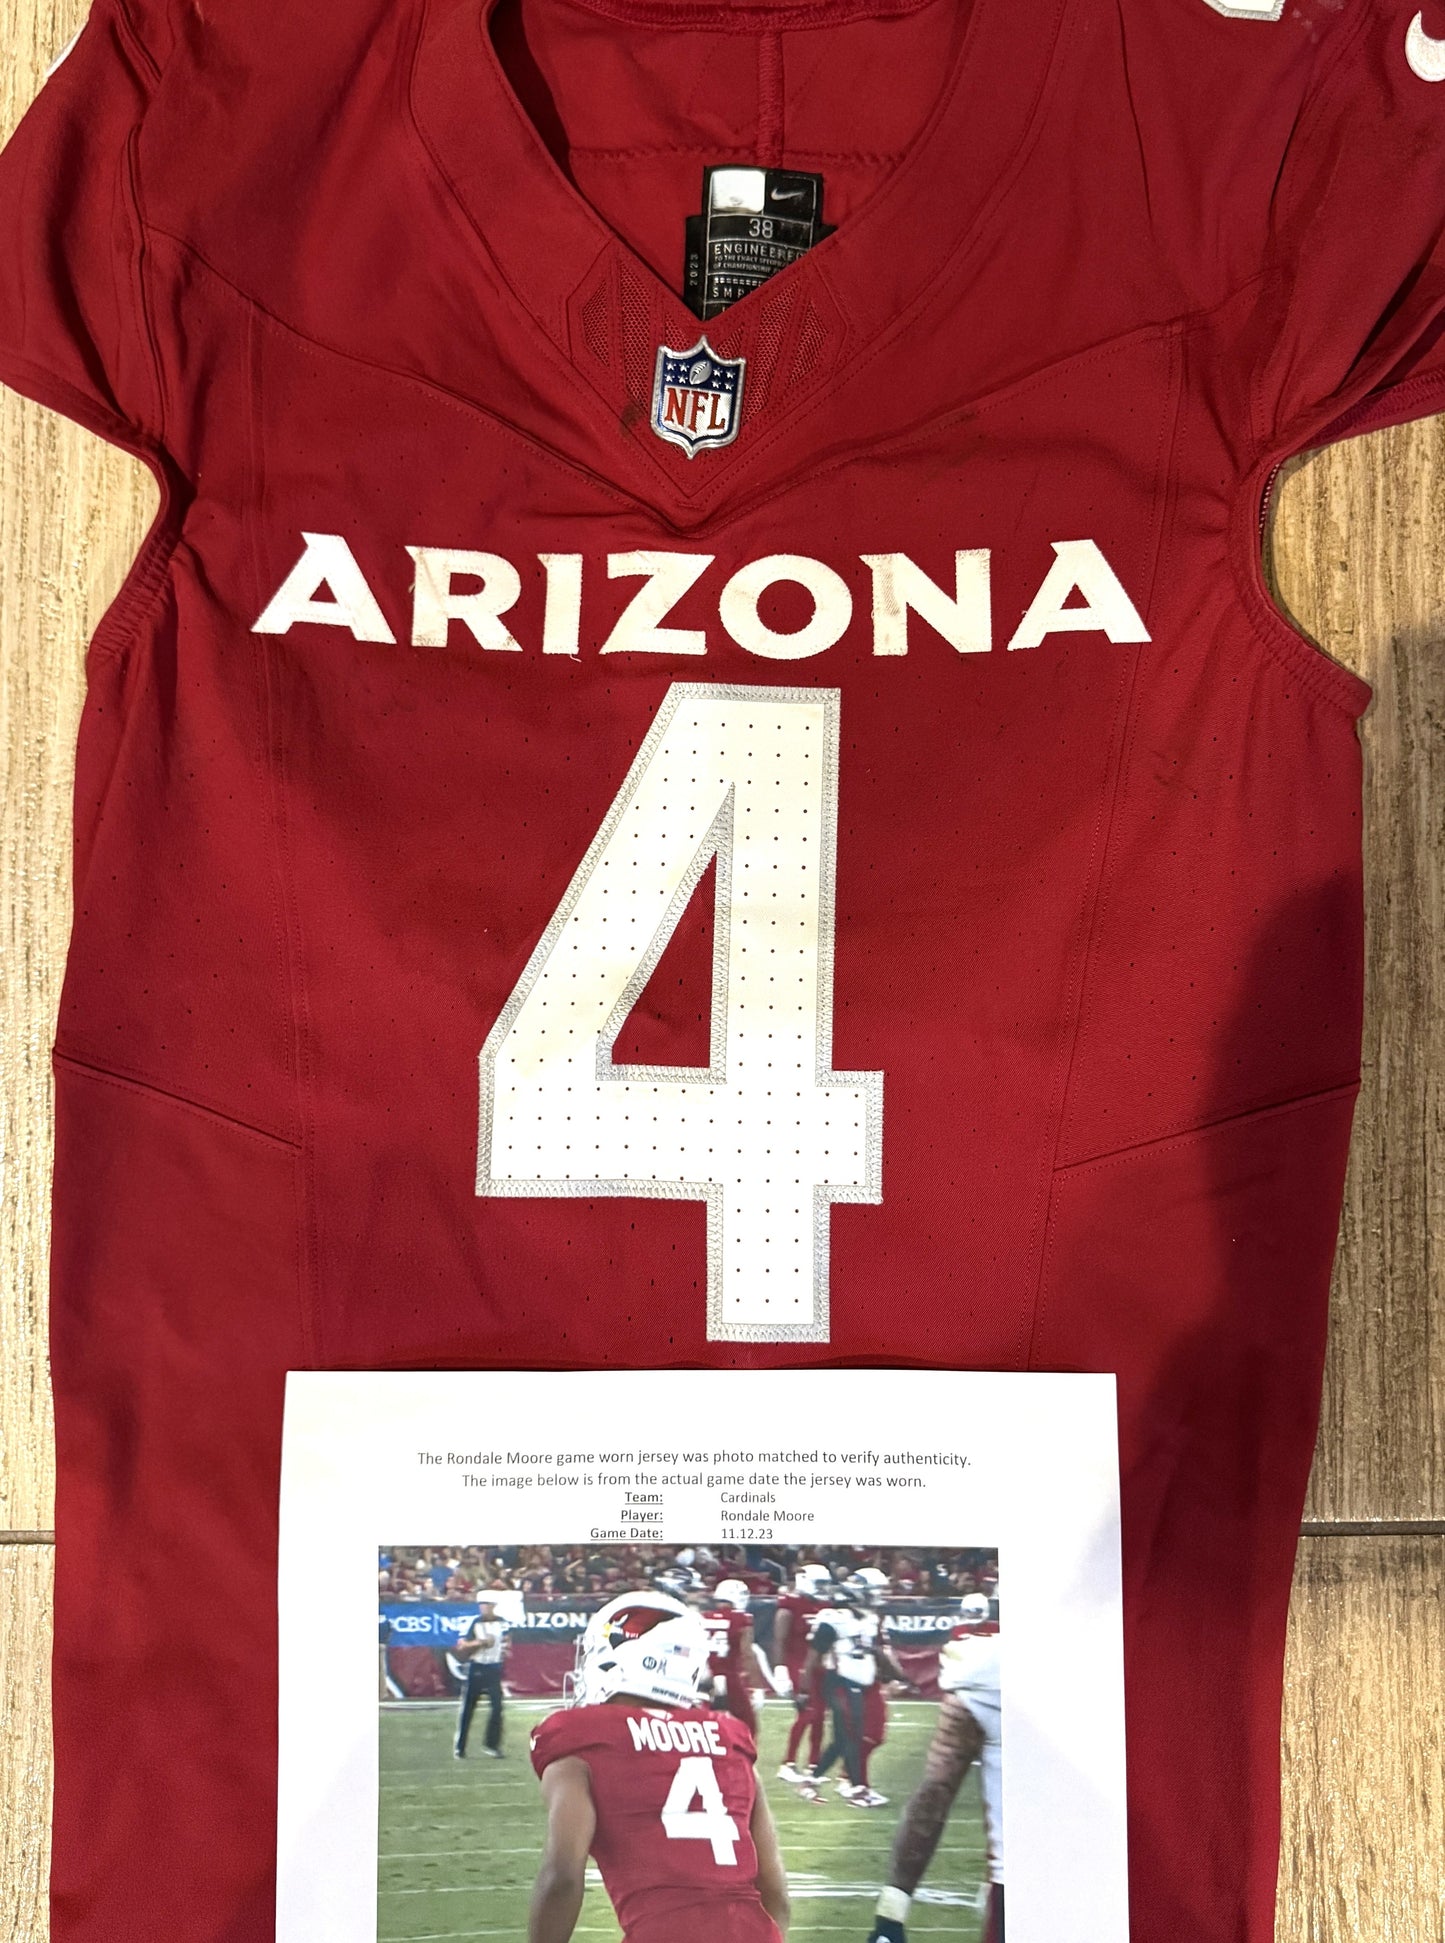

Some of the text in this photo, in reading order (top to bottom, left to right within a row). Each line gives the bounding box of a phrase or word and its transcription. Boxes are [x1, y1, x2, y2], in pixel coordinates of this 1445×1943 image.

[748, 218, 774, 239] 38
[689, 253, 699, 286] 2023
[664, 387, 726, 434] NFL
[250, 532, 1153, 661] ARIZONA
[475, 682, 885, 1344] 4
[417, 1449, 971, 1469] The Rondale Moore game worn jersey was photo matched to verify authenticity.
[461, 1472, 926, 1489] The image below is from the actual game date the jersey was worn.
[624, 1491, 663, 1503] Team:
[720, 1491, 776, 1503] Cardinals
[620, 1509, 664, 1523] Player:
[721, 1509, 815, 1522] Rondale Moore
[590, 1527, 663, 1539] Game Date:
[722, 1528, 773, 1540] 11.12.23
[391, 1616, 433, 1633] CBS
[510, 1611, 595, 1629] RIZON
[626, 1716, 728, 1756] MOORE
[660, 1756, 741, 1866] 4
